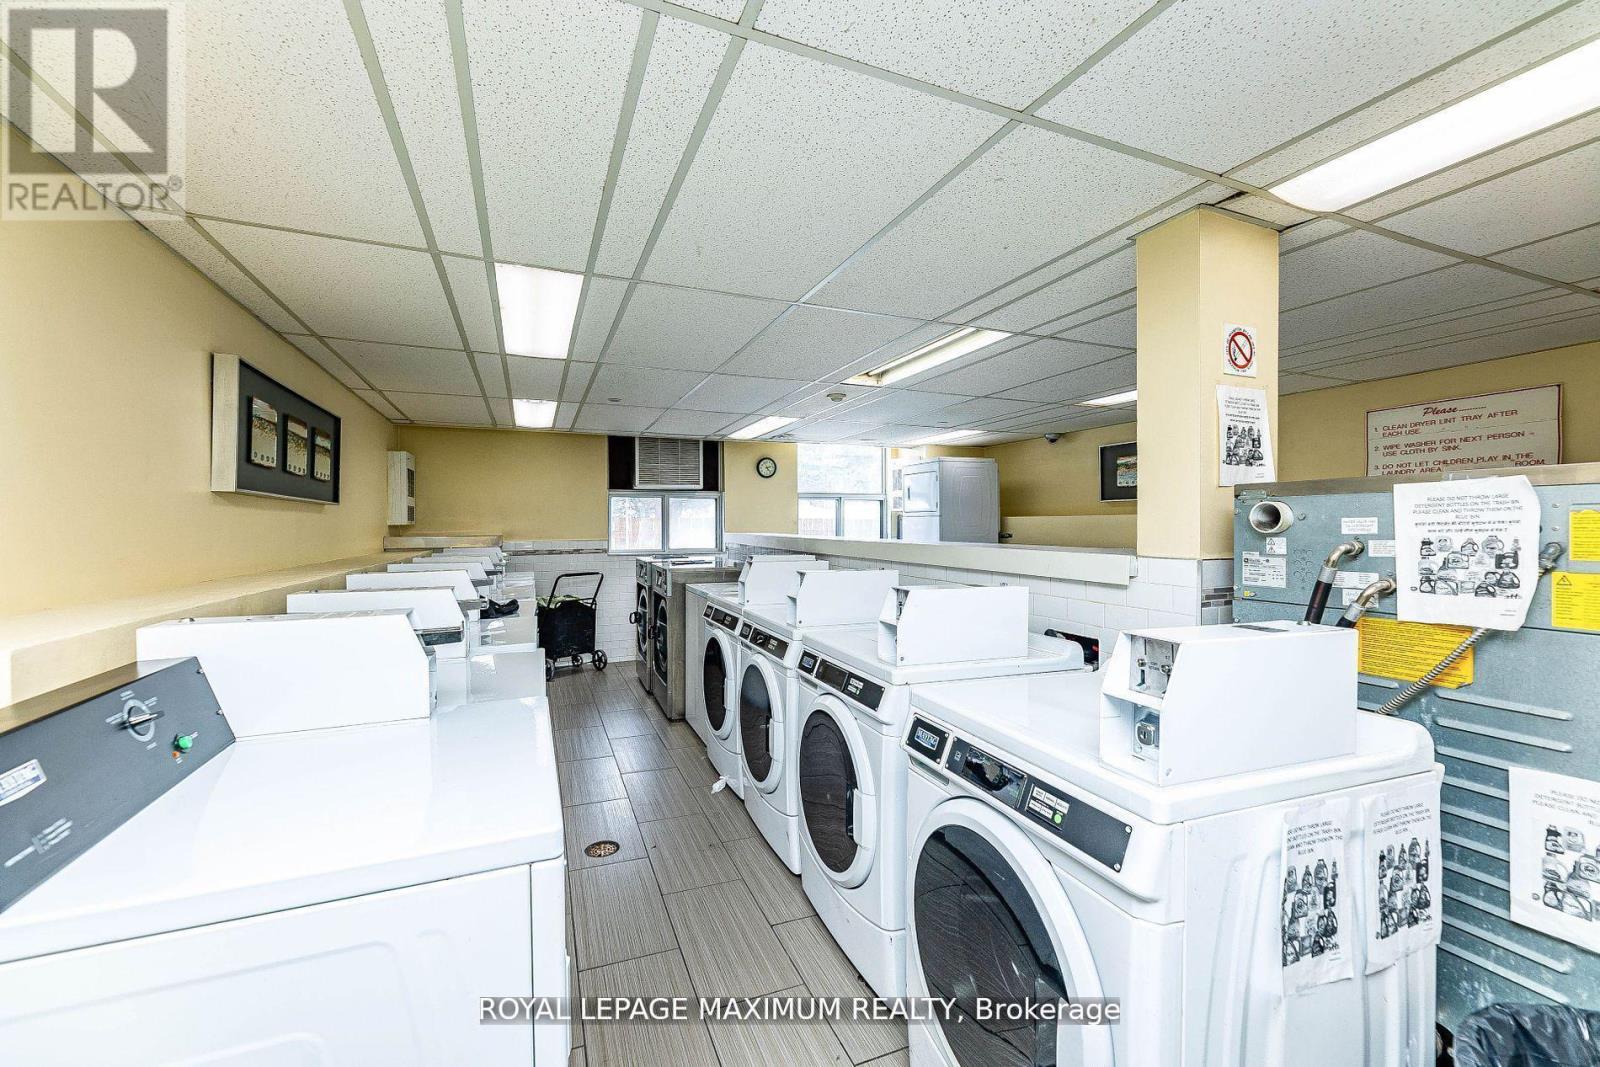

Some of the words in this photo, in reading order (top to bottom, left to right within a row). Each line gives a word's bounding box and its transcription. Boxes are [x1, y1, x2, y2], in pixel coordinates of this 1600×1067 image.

[1382, 423, 1407, 431] CLEAN
[1410, 419, 1436, 427] DRYER
[1460, 414, 1483, 422] TRAY
[1487, 409, 1519, 419] AFTER
[1383, 443, 1400, 451] WIPE
[1404, 440, 1436, 448] WASHER
[1460, 435, 1482, 443] NEXT
[1487, 431, 1525, 440] PERSON
[1400, 447, 1425, 455] CLOTH
[1433, 457, 1473, 466] CHILDREN
[1477, 455, 1498, 463] PLAY
[1515, 452, 1534, 460] THE
[1382, 467, 1416, 476] LAUNDRY
[1515, 459, 1545, 467] ROOM
